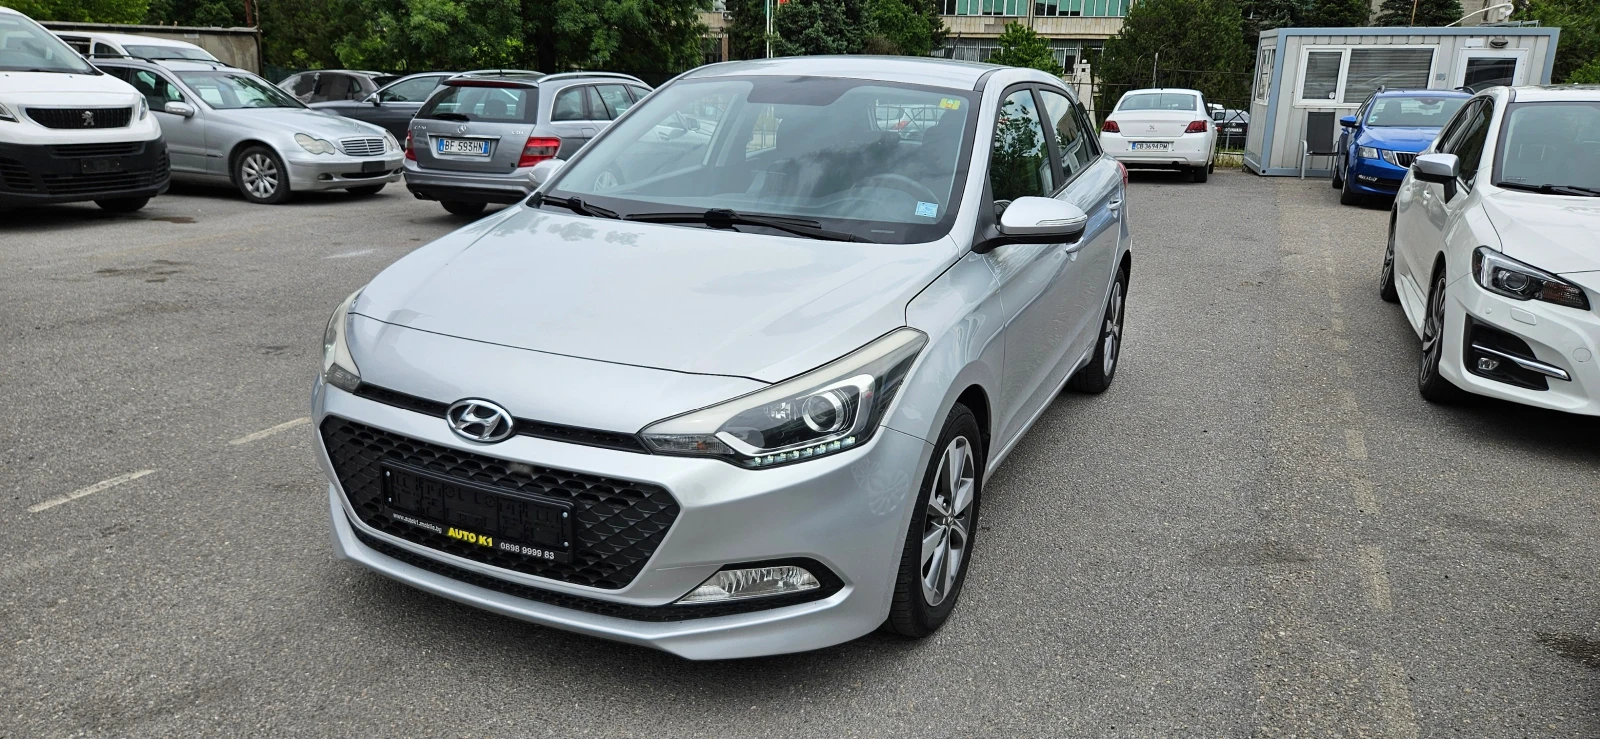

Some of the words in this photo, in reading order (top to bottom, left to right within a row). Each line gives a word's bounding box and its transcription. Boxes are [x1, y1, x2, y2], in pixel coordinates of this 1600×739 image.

[444, 140, 455, 151] BF
[457, 141, 484, 153] 593HN
[448, 527, 477, 543] AUTO
[478, 535, 493, 547] K1
[500, 542, 520, 553] 0898
[522, 546, 542, 557] 9999
[544, 550, 555, 560] 83
